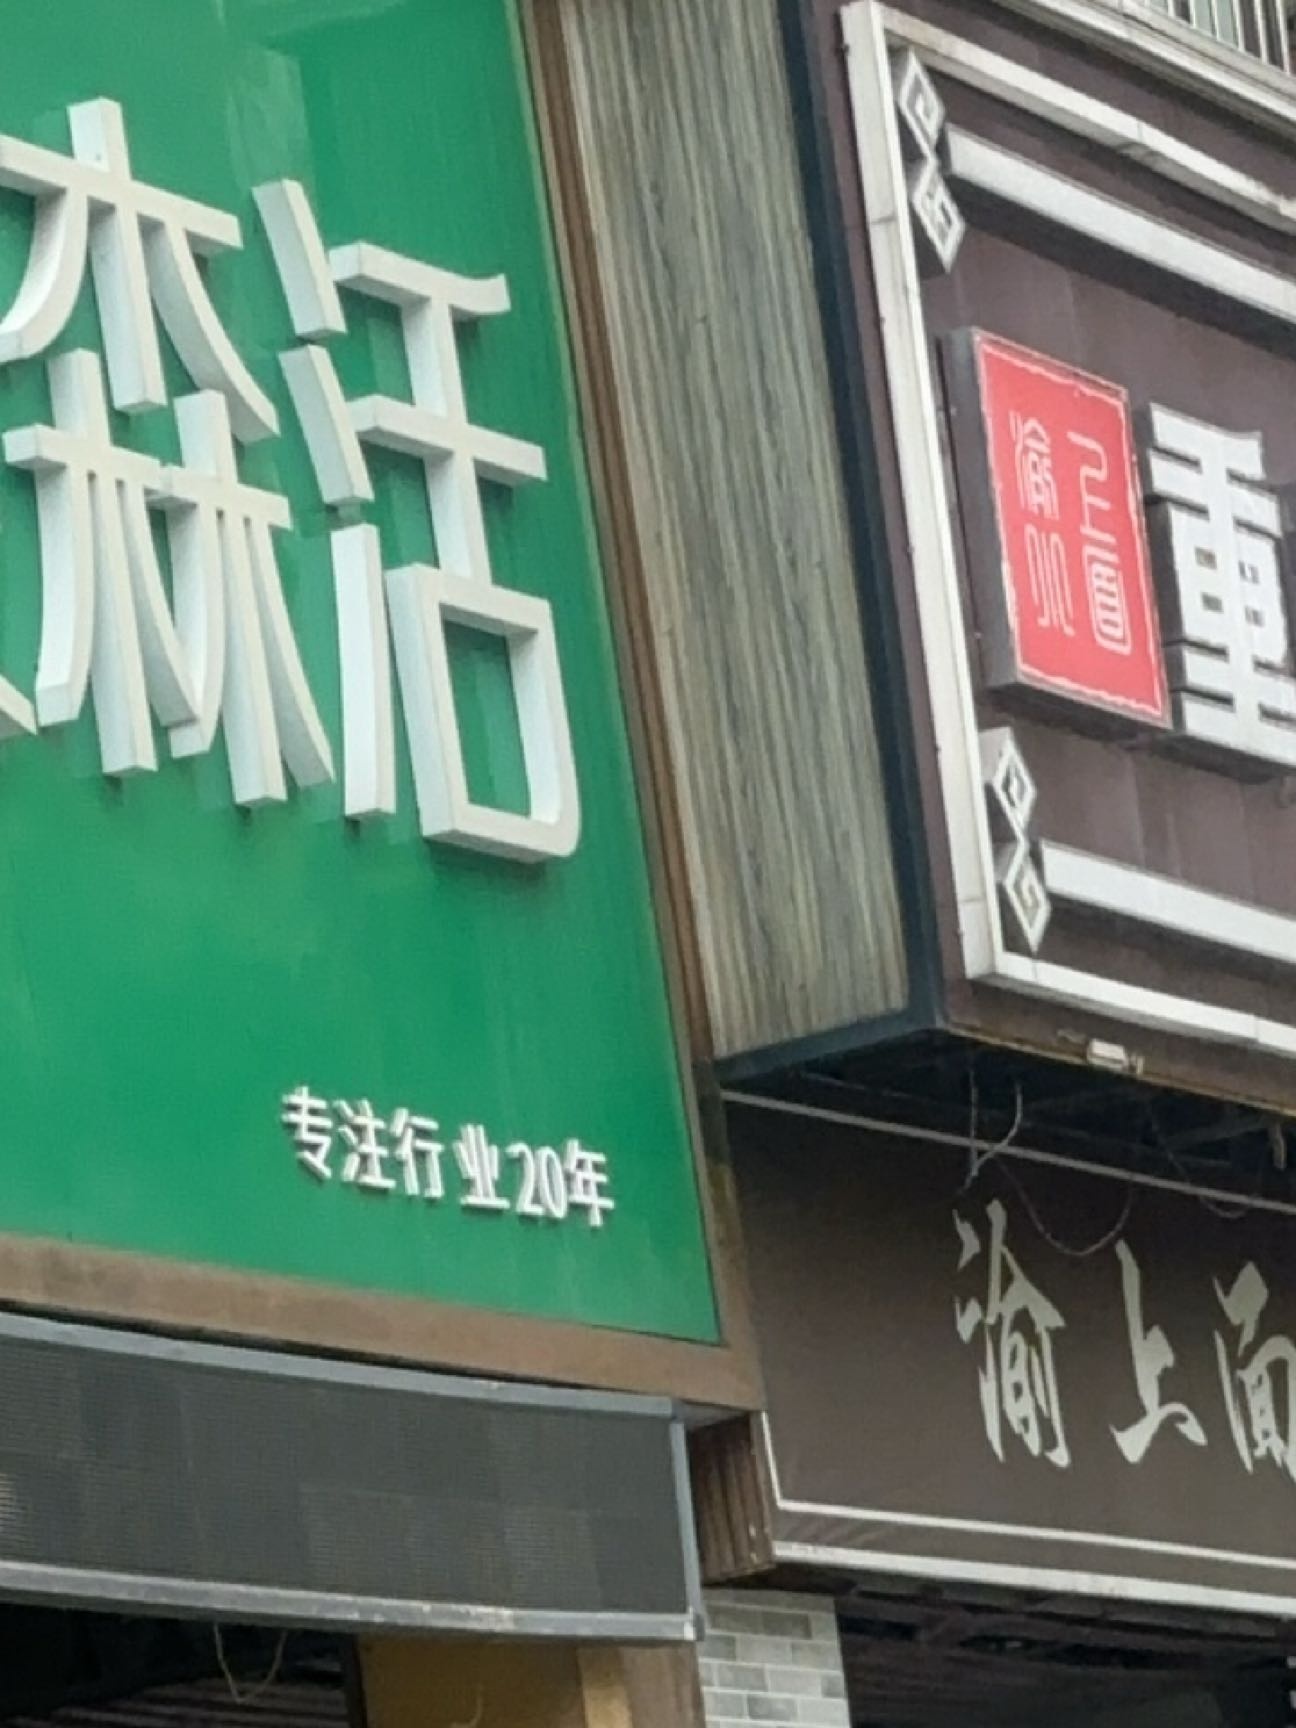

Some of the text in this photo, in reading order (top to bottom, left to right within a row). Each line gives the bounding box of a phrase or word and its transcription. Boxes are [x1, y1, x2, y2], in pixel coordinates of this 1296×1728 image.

[0, 97, 581, 858] 森活
[281, 1085, 616, 1227] 专注行业20年
